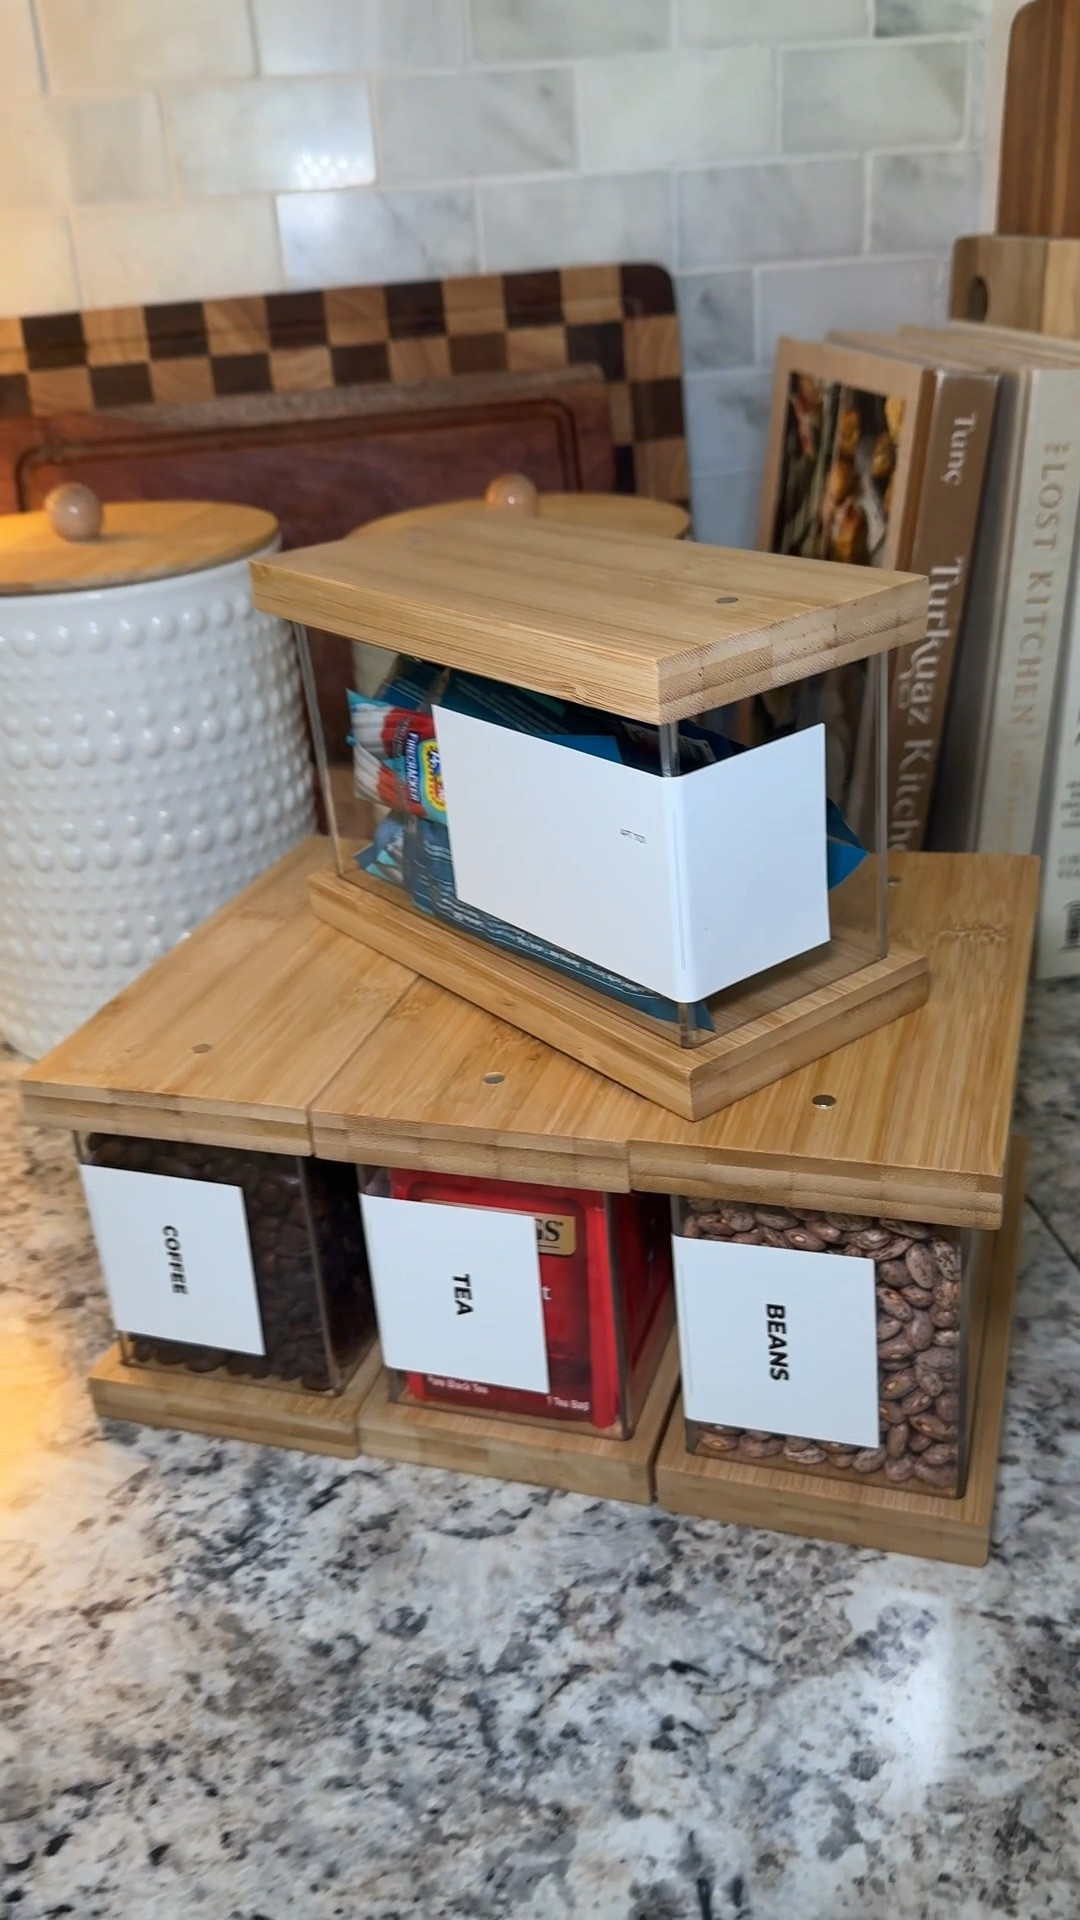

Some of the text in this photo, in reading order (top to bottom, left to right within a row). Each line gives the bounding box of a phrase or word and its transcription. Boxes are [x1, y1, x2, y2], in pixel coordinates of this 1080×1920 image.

[1033, 462, 1068, 549] LOST
[1010, 570, 1055, 726] KITCHEN
[404, 732, 421, 803] FIRECRACKER
[162, 1225, 188, 1295] COFFEE
[452, 1273, 474, 1315] TEA
[765, 1303, 790, 1381] BEANS
